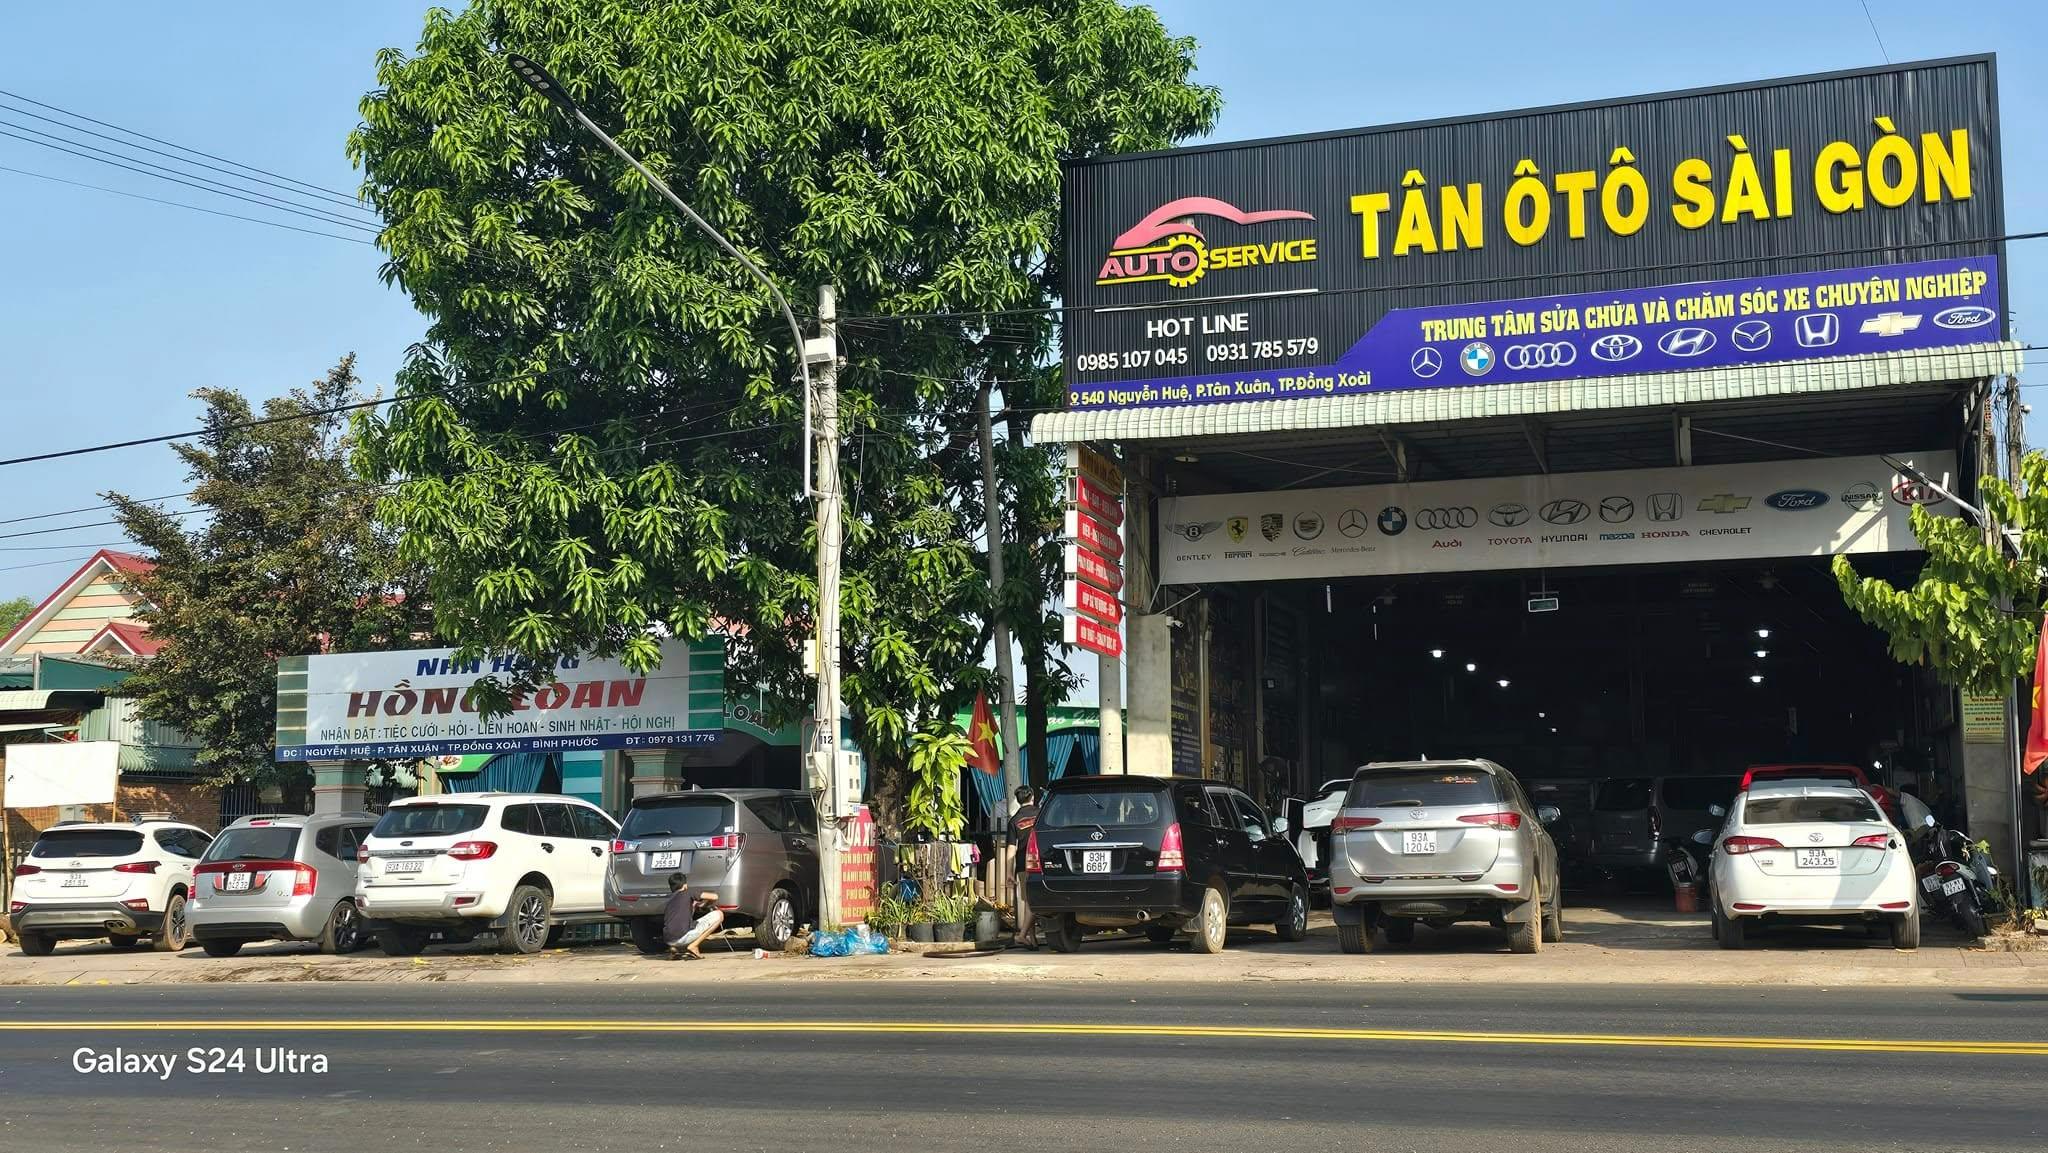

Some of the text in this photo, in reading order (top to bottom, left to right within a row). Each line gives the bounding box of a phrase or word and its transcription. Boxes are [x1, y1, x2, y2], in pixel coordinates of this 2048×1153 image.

[1351, 116, 1972, 260] TÂN ÔTÔ SÀI GÒN
[1099, 239, 1317, 279] AUTO SERVICE
[1421, 267, 1987, 342] TRUNG TÂM SỬA CHỮA VÀ CHĂM SÓC XE CHUYÊN NGHIỆP
[1147, 312, 1249, 339] HOT LINE
[1947, 312, 1981, 325] Ford
[1077, 337, 1319, 372] 0985 107 045 0931 785 579
[1081, 371, 1371, 405] 540 Nguyễn Huệ, P.Tân Xuân, TP.Đồng Xoài
[1778, 493, 1816, 507] Ford
[1844, 492, 1879, 500] NISSAN
[1432, 539, 1463, 549] Audi
[1487, 536, 1533, 546] TOYOTA
[1541, 532, 1588, 543] HYUNDAI
[1599, 532, 1635, 541] mazda
[1641, 530, 1690, 539] HONDA
[1699, 527, 1751, 536] CHEVROLET
[321, 727, 351, 742] NHẬN
[383, 724, 407, 740] TIỆC
[411, 722, 438, 738] CƯỚI
[507, 720, 538, 734] HOAN
[549, 720, 576, 733] SINH
[580, 717, 611, 732] NHẬT
[622, 715, 641, 731] HỘI
[646, 716, 675, 730] NGHỊ
[305, 745, 347, 757] NGUYỄN
[350, 745, 371, 756] HUỆ
[410, 743, 439, 753] XUÂN
[496, 737, 521, 750] XOÀI
[532, 737, 558, 749] BÌNH
[561, 735, 599, 747] PHƯỚC
[648, 735, 673, 745] 0978
[676, 734, 693, 743] 131
[696, 733, 715, 742] 776
[1410, 832, 1429, 842] 93A
[1089, 852, 1106, 862] 93H
[1802, 857, 1835, 866] 243.25
[1808, 849, 1826, 857] 93A
[1086, 862, 1108, 872] 6687
